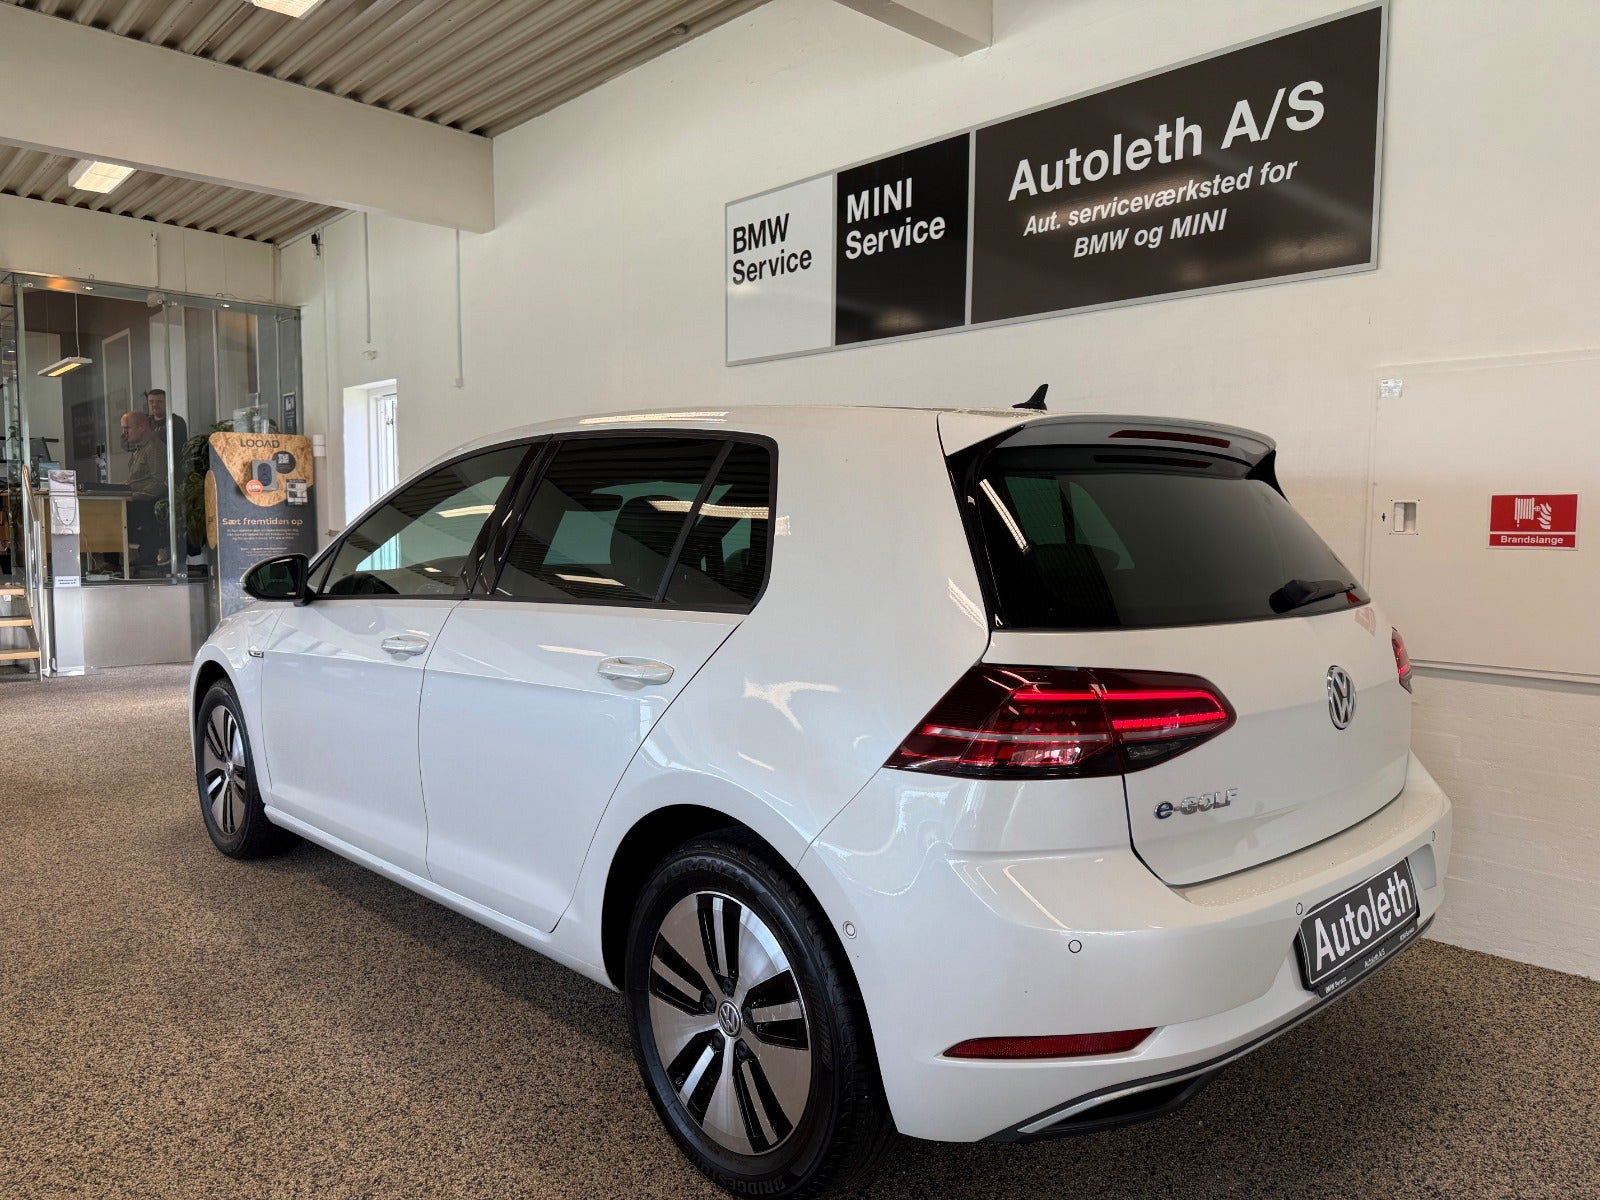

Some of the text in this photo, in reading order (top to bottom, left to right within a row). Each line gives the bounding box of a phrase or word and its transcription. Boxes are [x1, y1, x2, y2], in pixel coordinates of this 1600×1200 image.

[1009, 81, 1324, 201] Autoleth A/S
[848, 178, 912, 223] MINI
[1023, 161, 1298, 236] Aut. serviceværksted for
[733, 213, 790, 254] BMW
[846, 217, 945, 259] Service
[1074, 209, 1227, 257] BMW og MINI
[733, 249, 812, 285] Service
[222, 518, 304, 527] Sæt fremtiden op
[1501, 535, 1563, 546] Brandslange
[1154, 787, 1239, 819] e-GOLF
[1315, 871, 1412, 972] Autoleth
